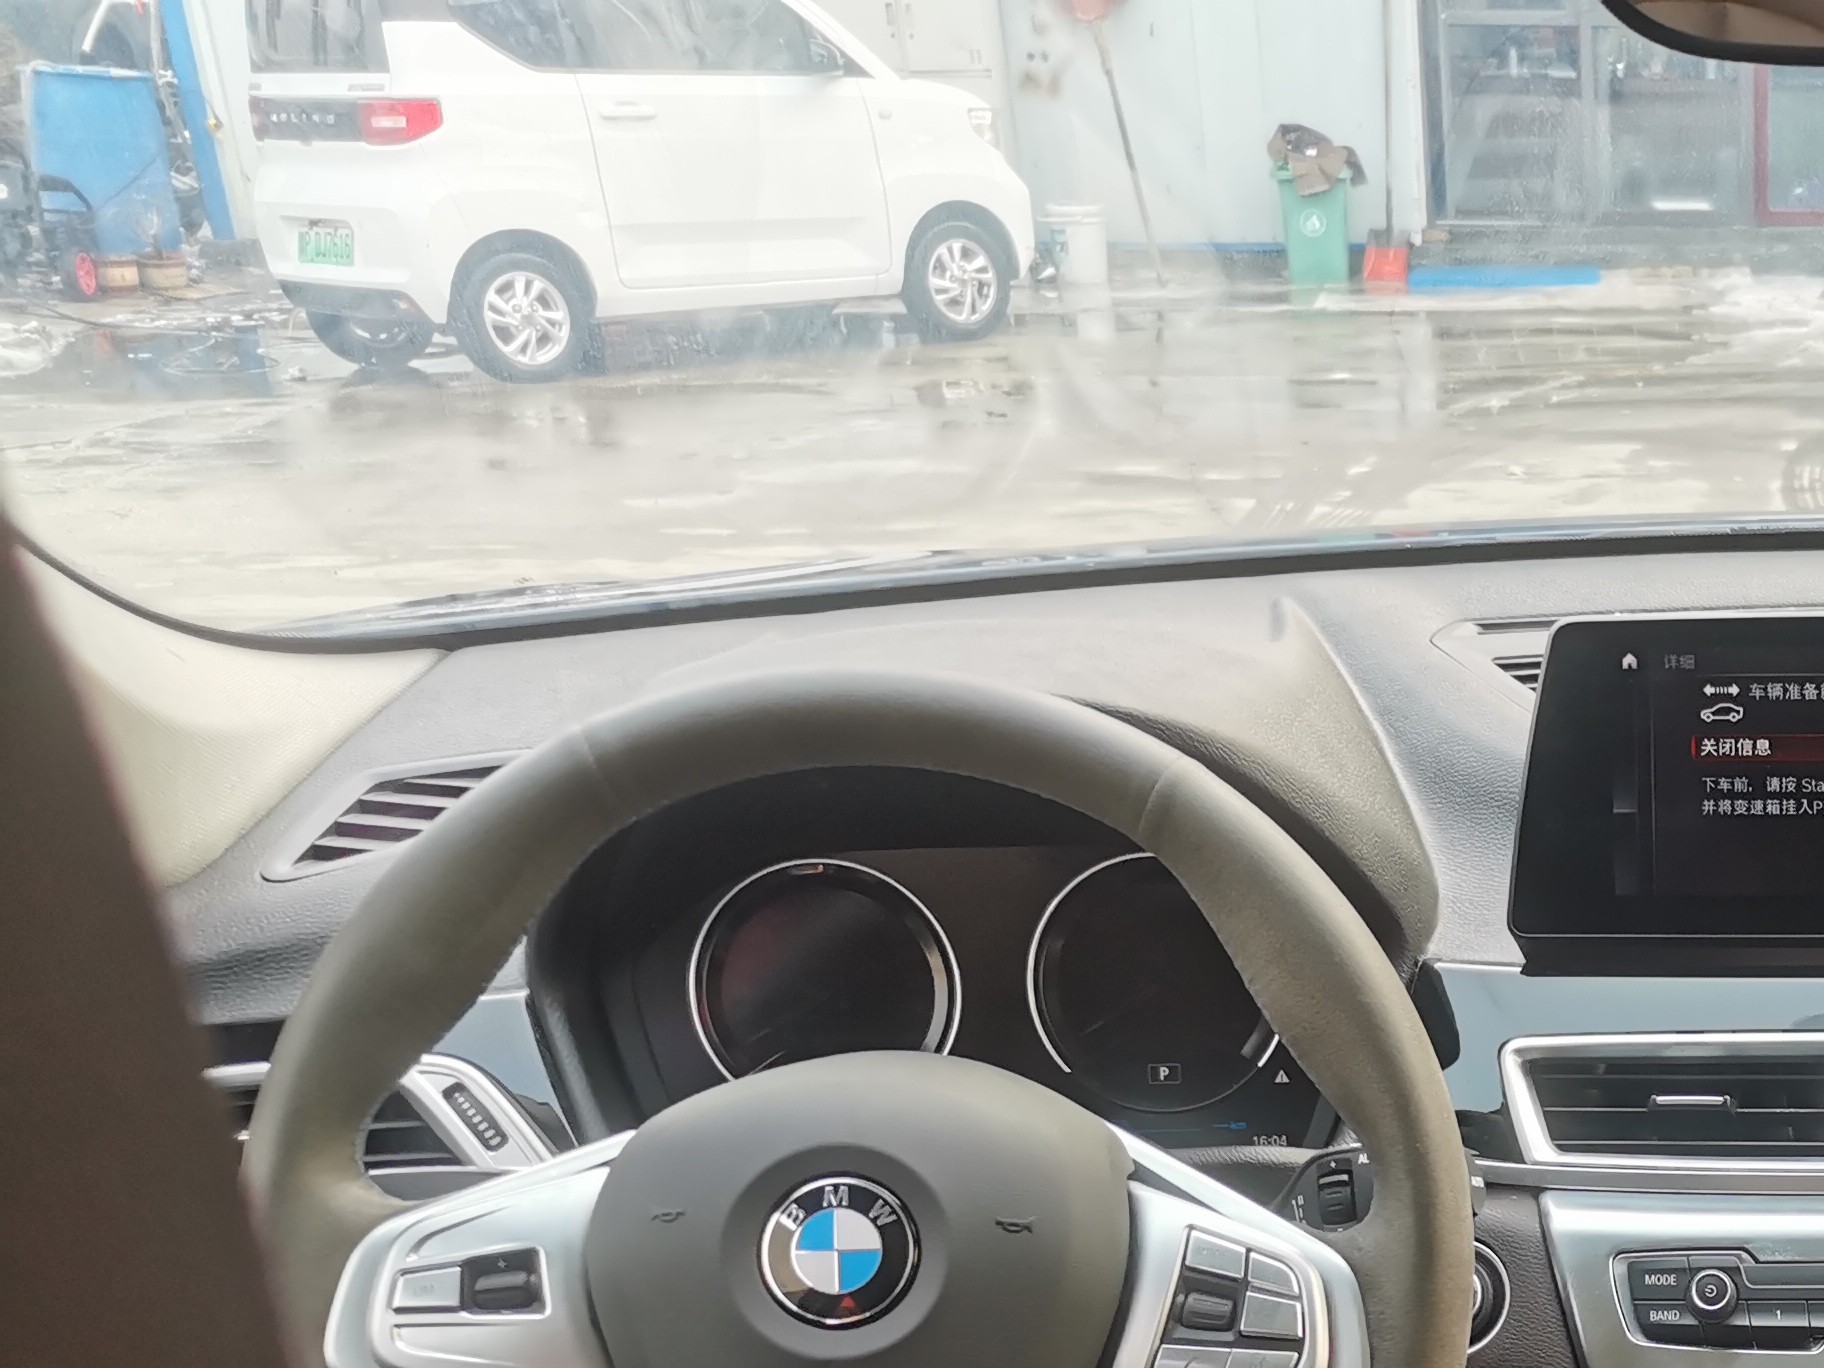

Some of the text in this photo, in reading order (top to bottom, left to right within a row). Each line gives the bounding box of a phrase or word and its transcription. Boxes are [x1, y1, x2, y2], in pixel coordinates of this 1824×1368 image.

[1663, 654, 1695, 670] 详细
[1700, 738, 1772, 757] 关闭信息
[1159, 1066, 1170, 1082] P
[1252, 1134, 1288, 1147] 16:04
[778, 1185, 898, 1232] BMW
[1644, 1273, 1677, 1287] MODE
[1649, 1308, 1681, 1323] BAND
